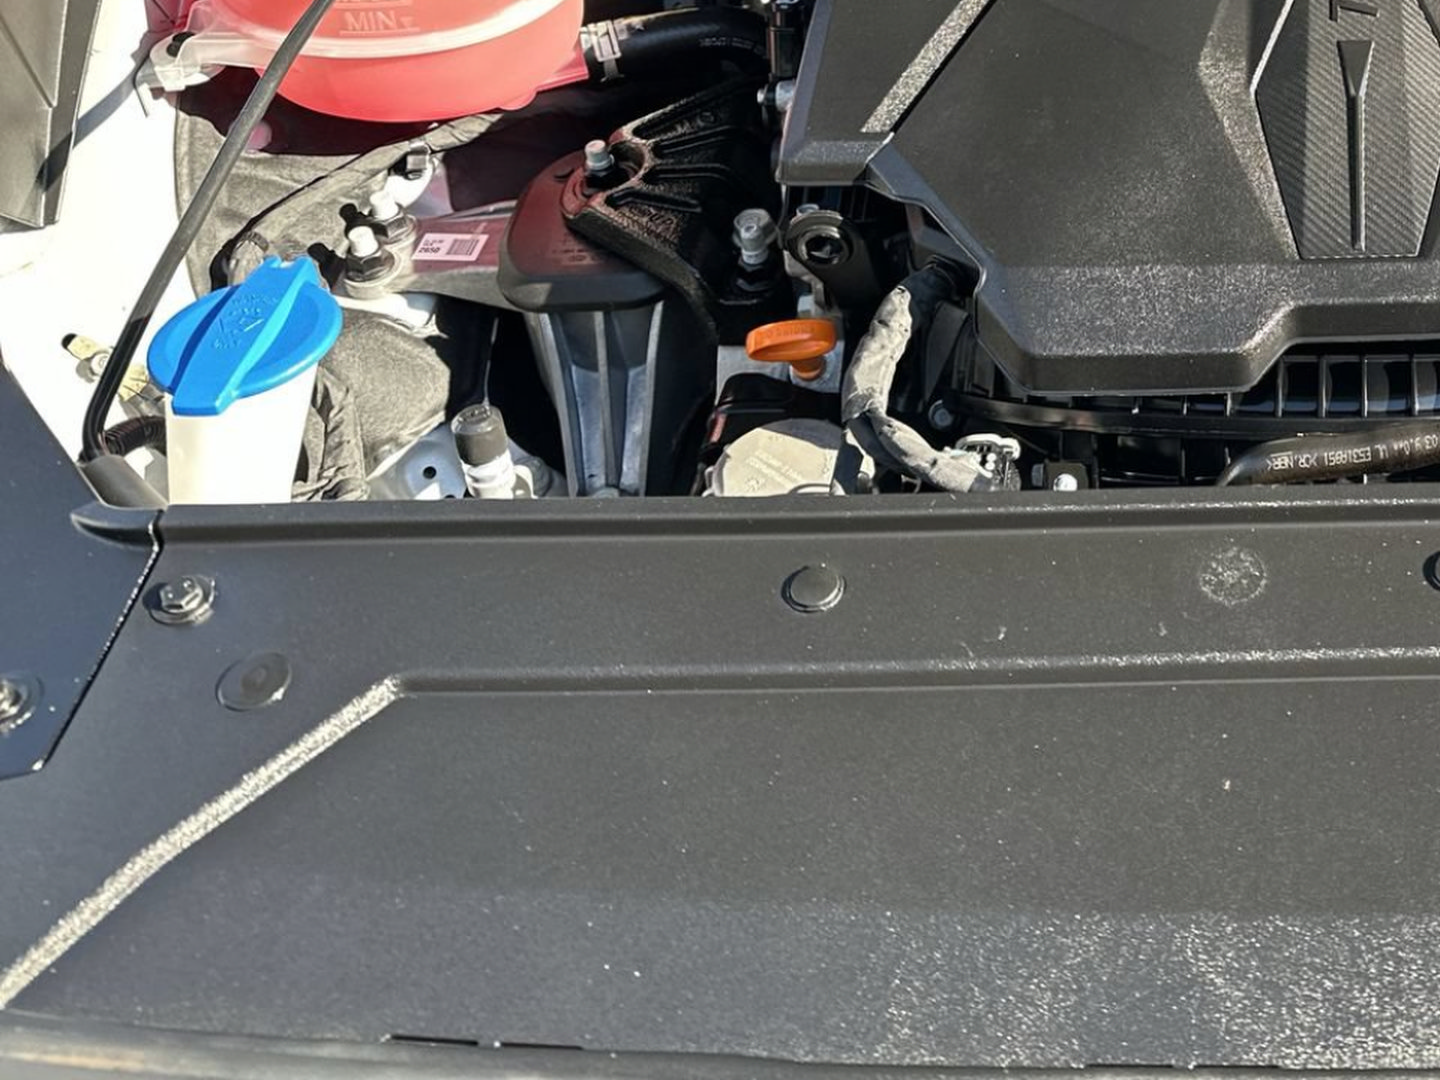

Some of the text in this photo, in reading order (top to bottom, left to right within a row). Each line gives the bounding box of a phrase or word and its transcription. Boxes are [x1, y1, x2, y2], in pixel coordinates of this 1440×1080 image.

[344, 10, 398, 31] MIN
[1424, 434, 1439, 449] 03
[1375, 444, 1389, 459] UL
